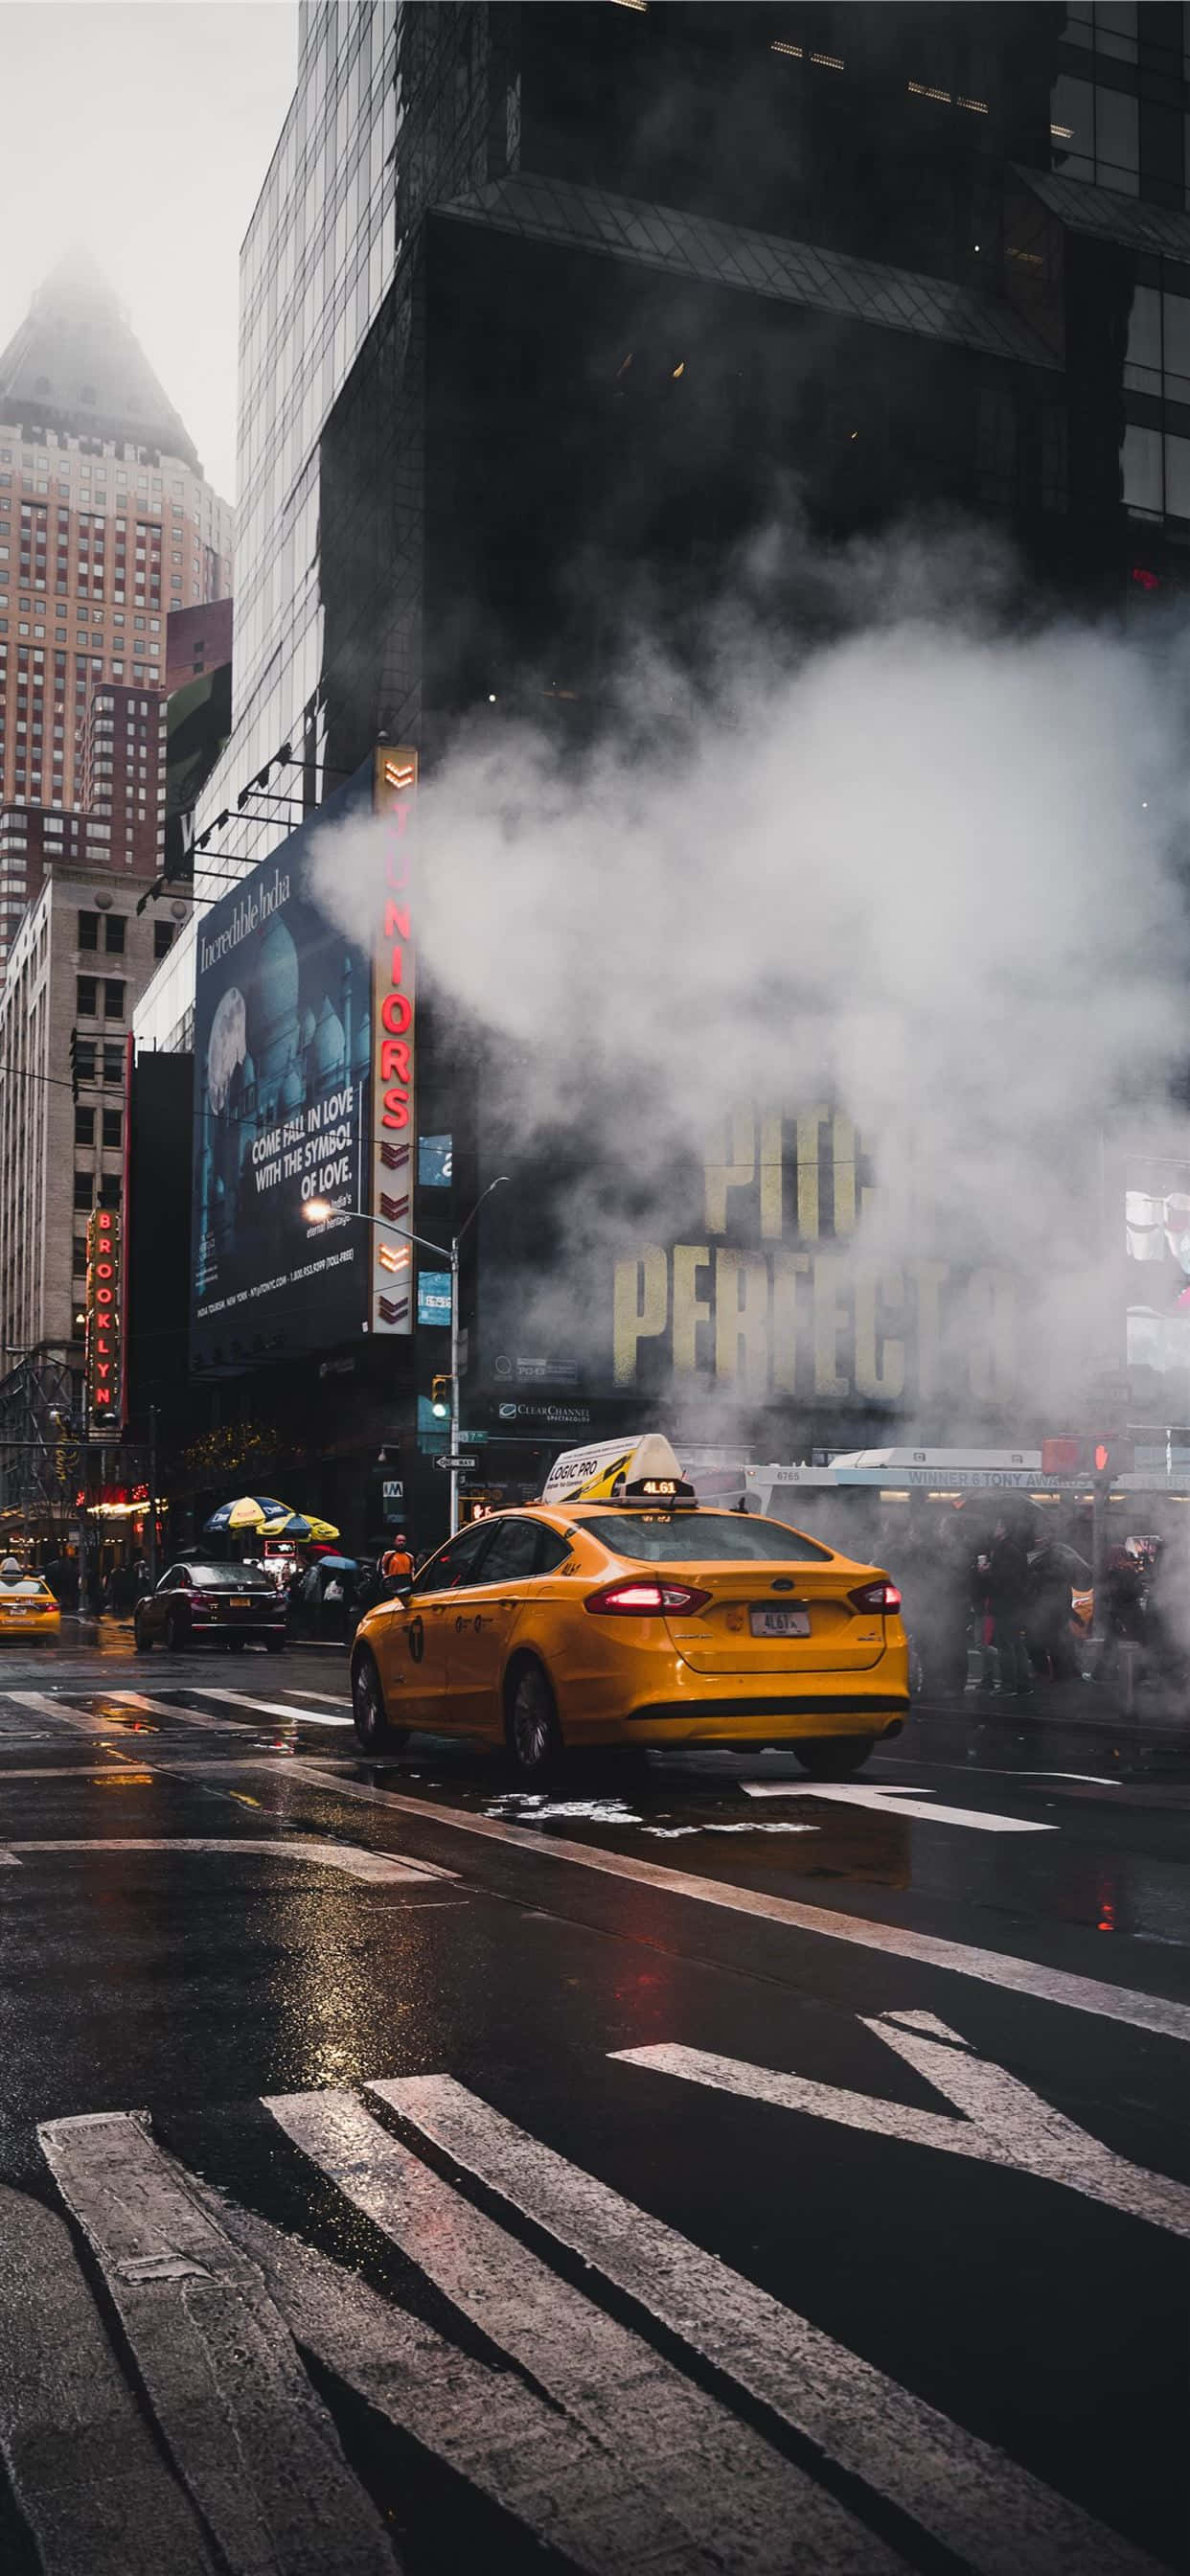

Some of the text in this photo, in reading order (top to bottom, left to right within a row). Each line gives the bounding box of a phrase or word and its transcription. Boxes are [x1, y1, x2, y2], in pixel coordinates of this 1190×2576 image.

[200, 893, 259, 975] Incredible
[380, 803, 413, 1129] JUNIORS
[252, 1086, 354, 1164] COME FALL IN LOVE
[255, 1121, 353, 1193] WITH THE SYMBOL
[301, 1156, 353, 1201] OF LOVE.
[97, 1213, 113, 1404] BROOKLYN
[612, 1243, 949, 1402] PERFECT
[548, 1460, 598, 1482] LOGIC PRO
[643, 1481, 677, 1494] 4L61
[909, 1470, 969, 1485] WINNER
[983, 1473, 1021, 1486] TONY
